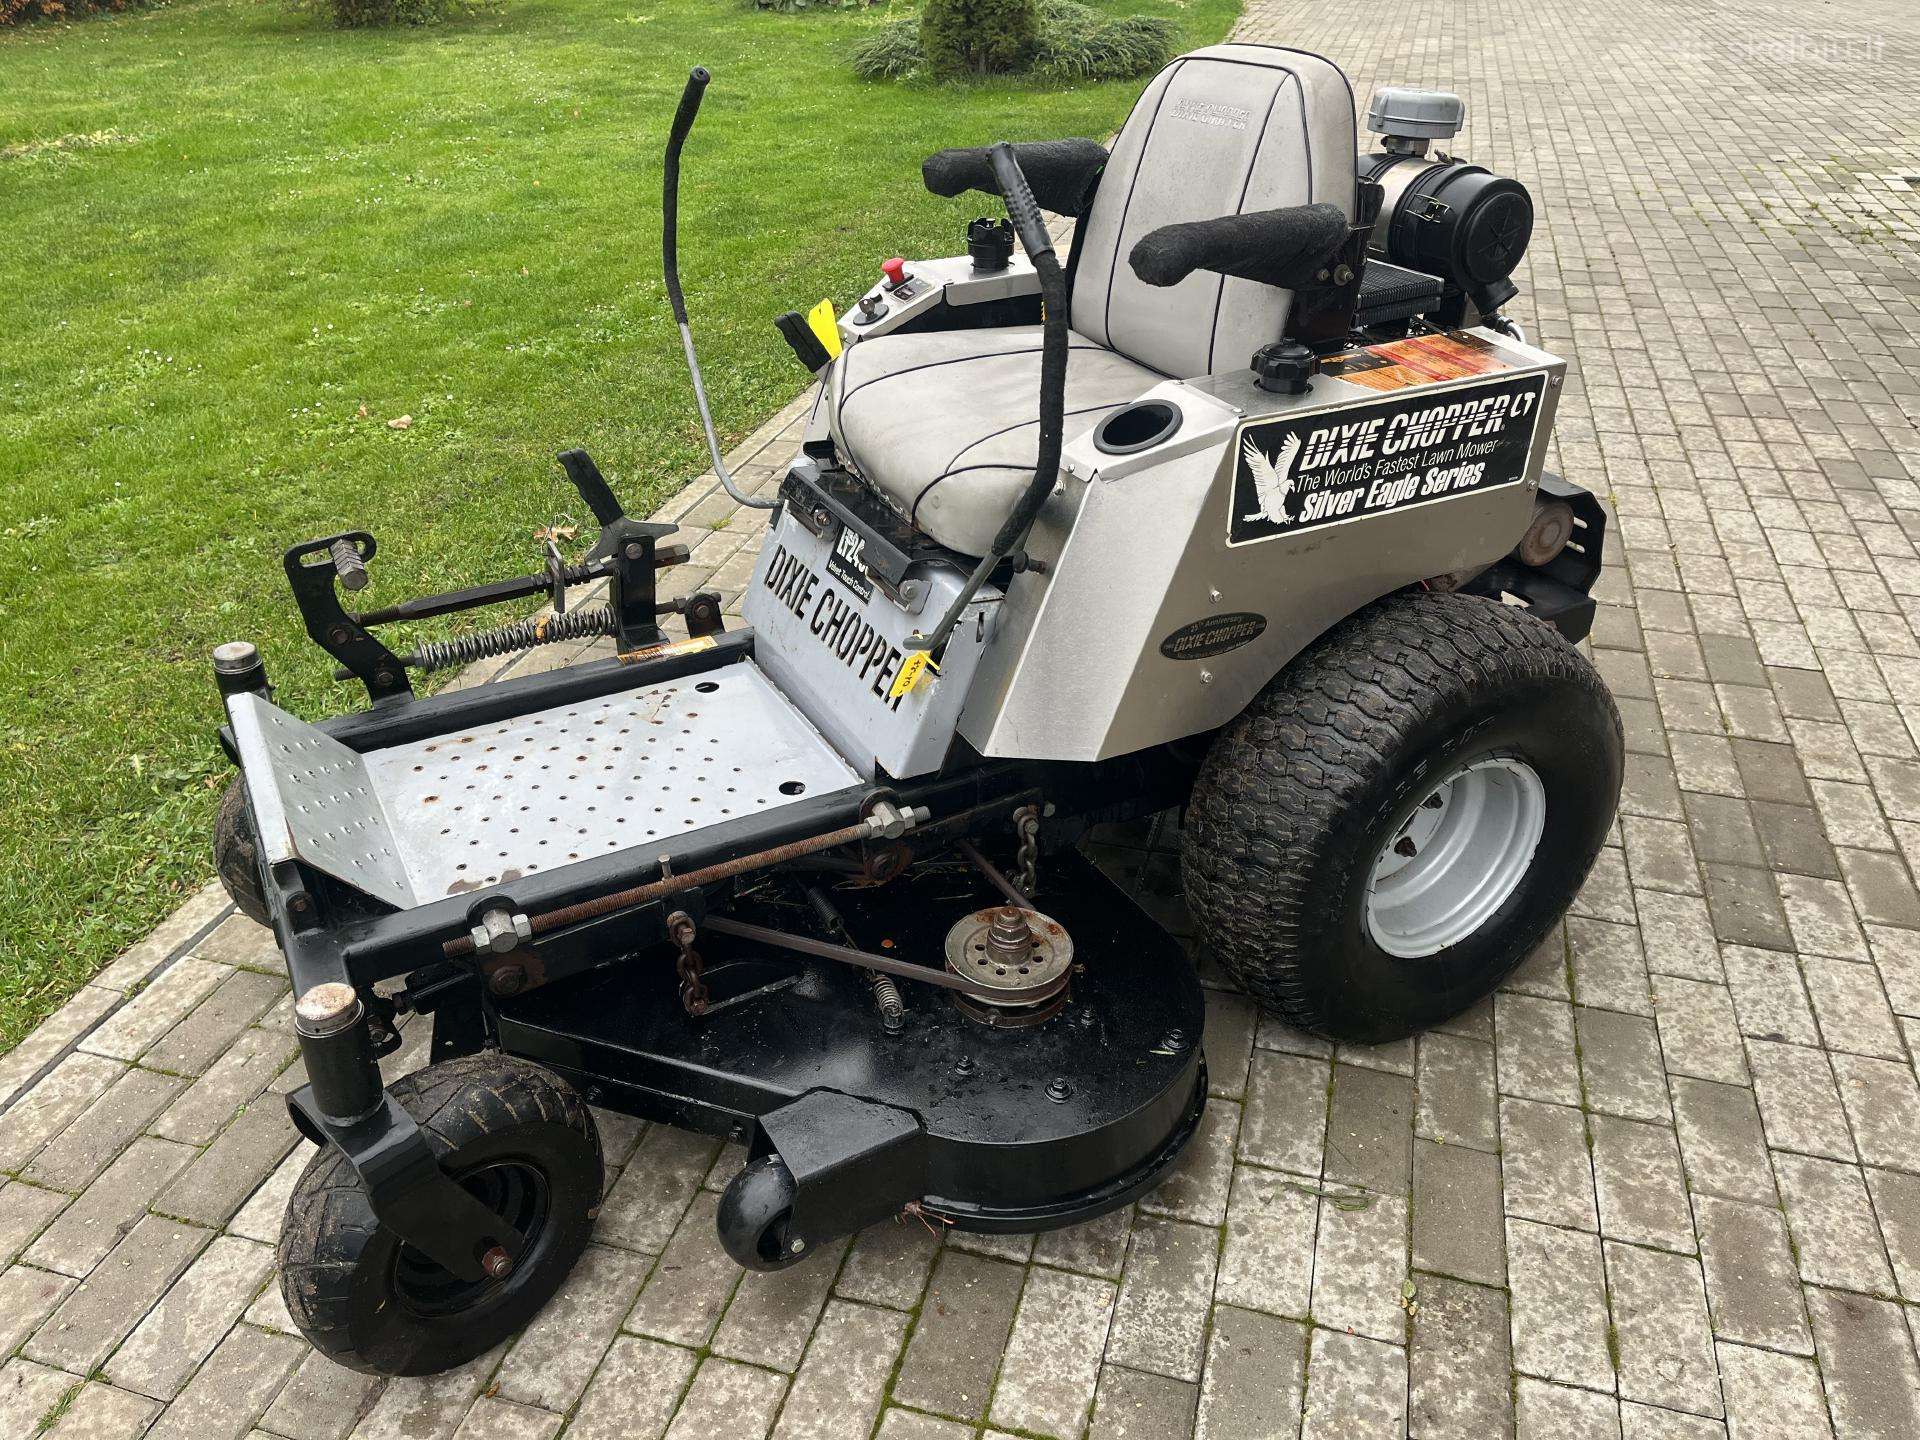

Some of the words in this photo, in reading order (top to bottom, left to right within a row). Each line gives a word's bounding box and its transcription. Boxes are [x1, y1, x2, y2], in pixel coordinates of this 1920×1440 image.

[1299, 418, 1386, 471] DIXIE
[1382, 394, 1511, 455] CHOPPER
[1296, 474, 1321, 493] The
[1325, 462, 1372, 487] World's
[1374, 453, 1420, 478] Fastest
[1422, 449, 1455, 467] Lawn
[1455, 438, 1500, 460] Mower
[1299, 487, 1366, 523] Silver
[1364, 473, 1420, 509] Eagle
[1420, 461, 1486, 496] Series
[764, 544, 820, 620] DIXIE
[840, 569, 854, 586] Touch
[1173, 632, 1206, 653] DIXIE
[1205, 621, 1257, 645] CHOPPER
